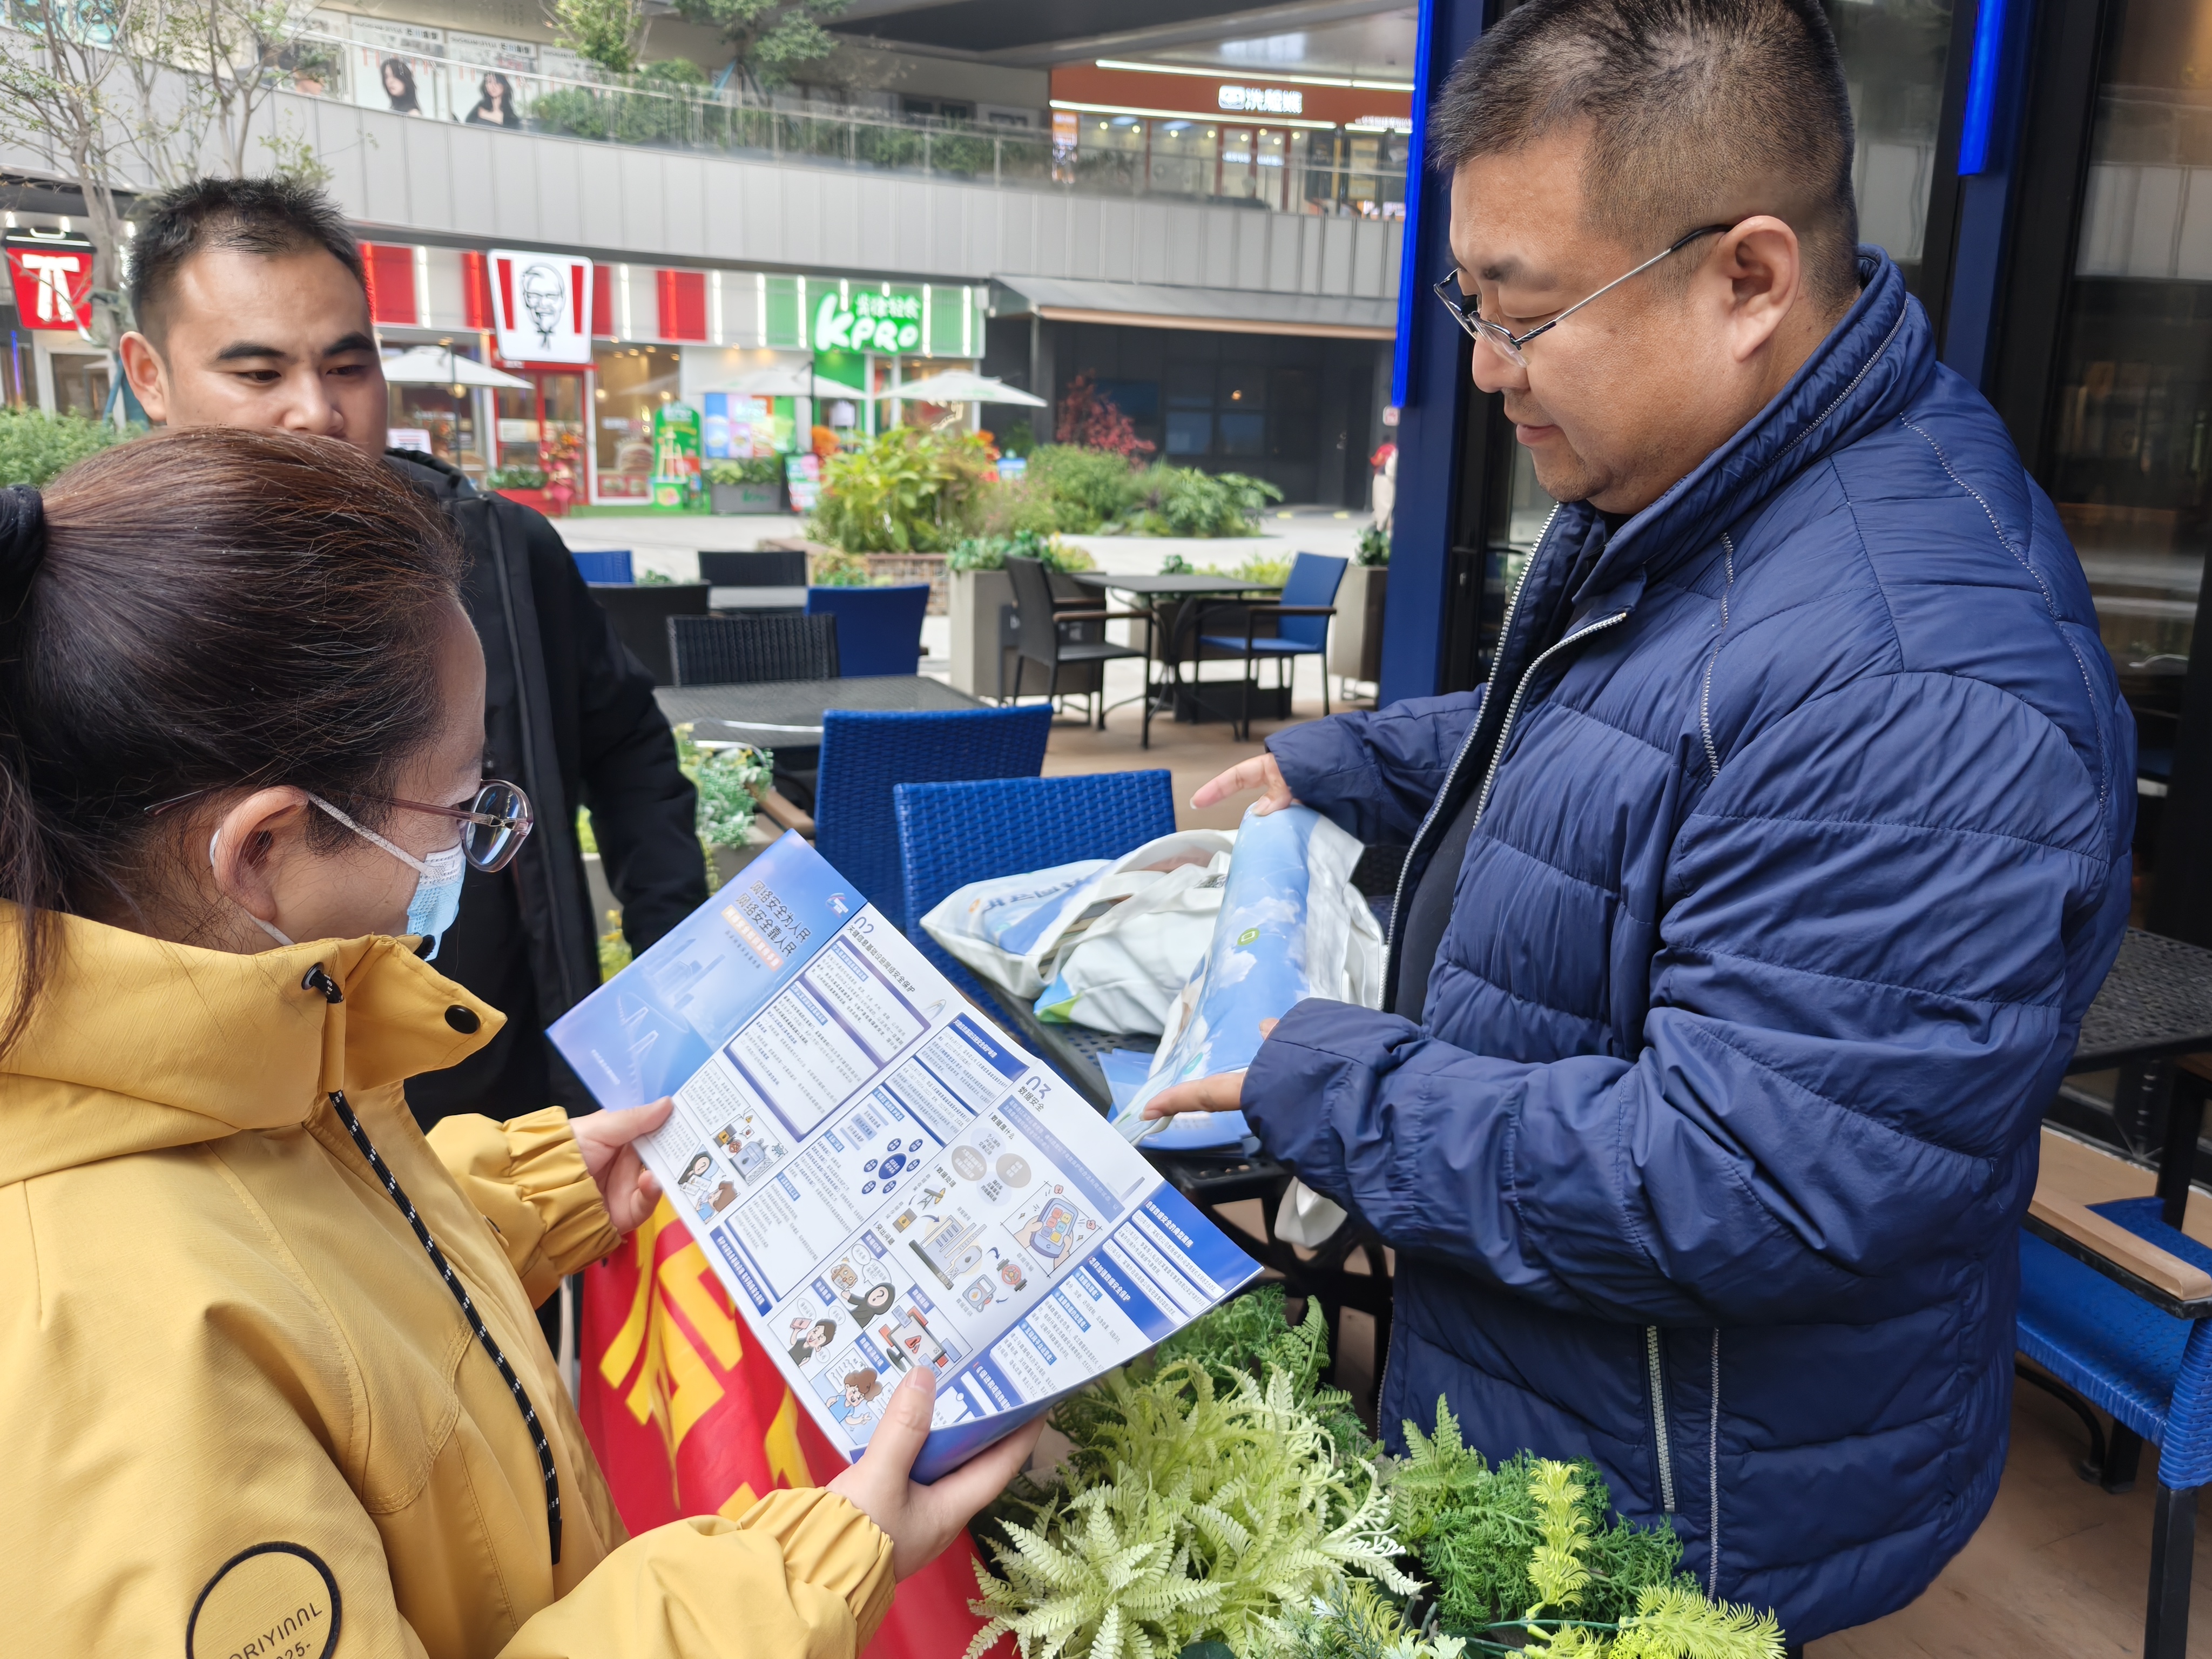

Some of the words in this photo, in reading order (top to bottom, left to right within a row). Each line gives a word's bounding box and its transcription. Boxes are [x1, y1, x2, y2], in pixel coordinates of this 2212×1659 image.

[749, 879, 812, 943] 网络安全为人民
[734, 892, 798, 957] 网络安全靠人民
[1017, 1085, 1046, 1112] 数据安全
[990, 1114, 1016, 1140] 数据是什么
[936, 1165, 956, 1188] 数据处理
[875, 1223, 895, 1245] 突出问题
